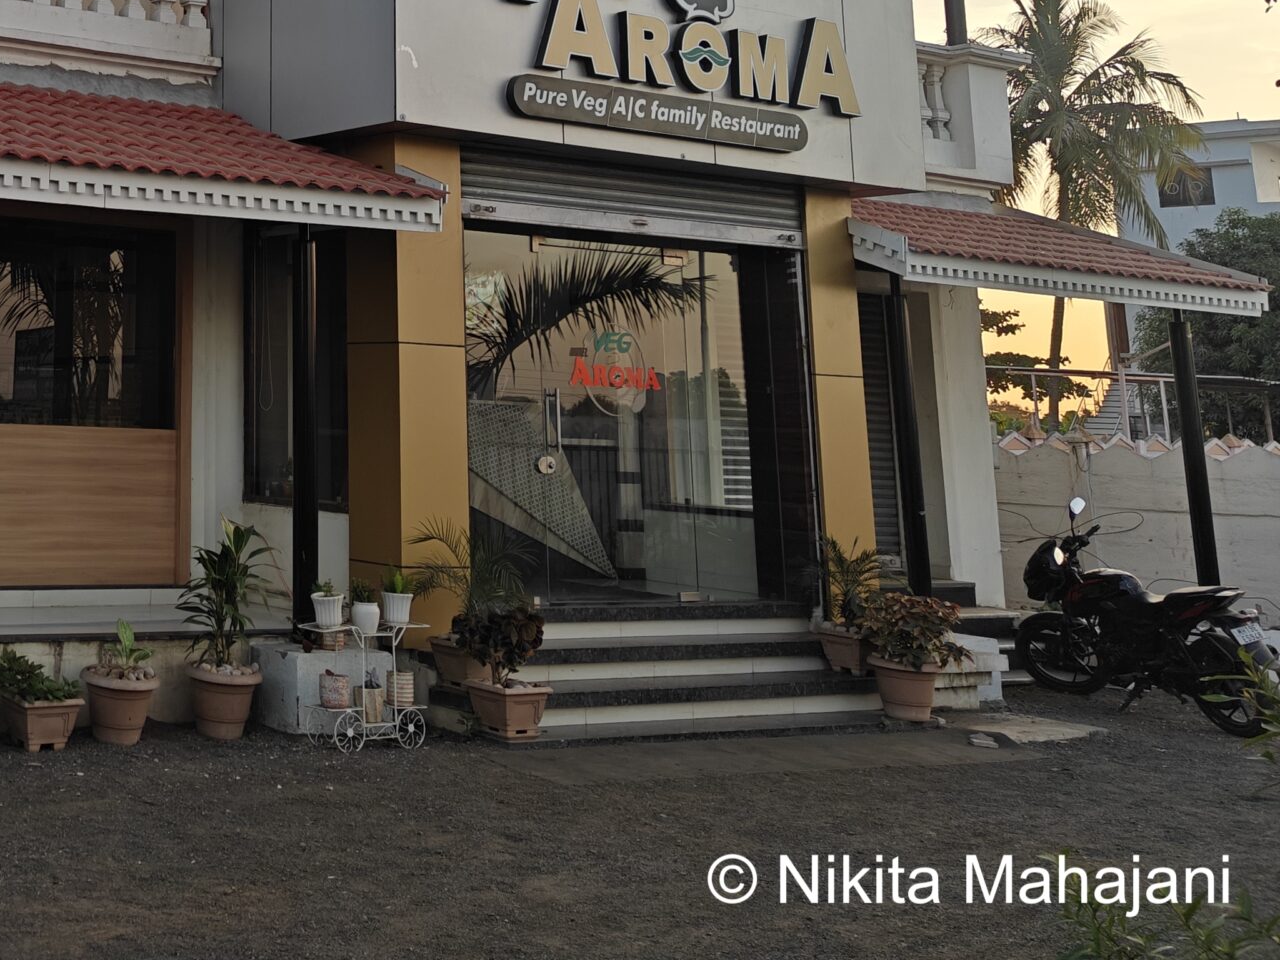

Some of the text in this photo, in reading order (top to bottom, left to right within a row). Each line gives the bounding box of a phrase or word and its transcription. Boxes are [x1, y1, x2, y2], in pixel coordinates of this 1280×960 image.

[523, 82, 568, 107] Pure
[572, 89, 608, 118] Veg
[650, 100, 707, 132] family
[710, 109, 801, 141] Restaurant
[594, 331, 632, 354] VEG
[569, 355, 661, 392] AROMA
